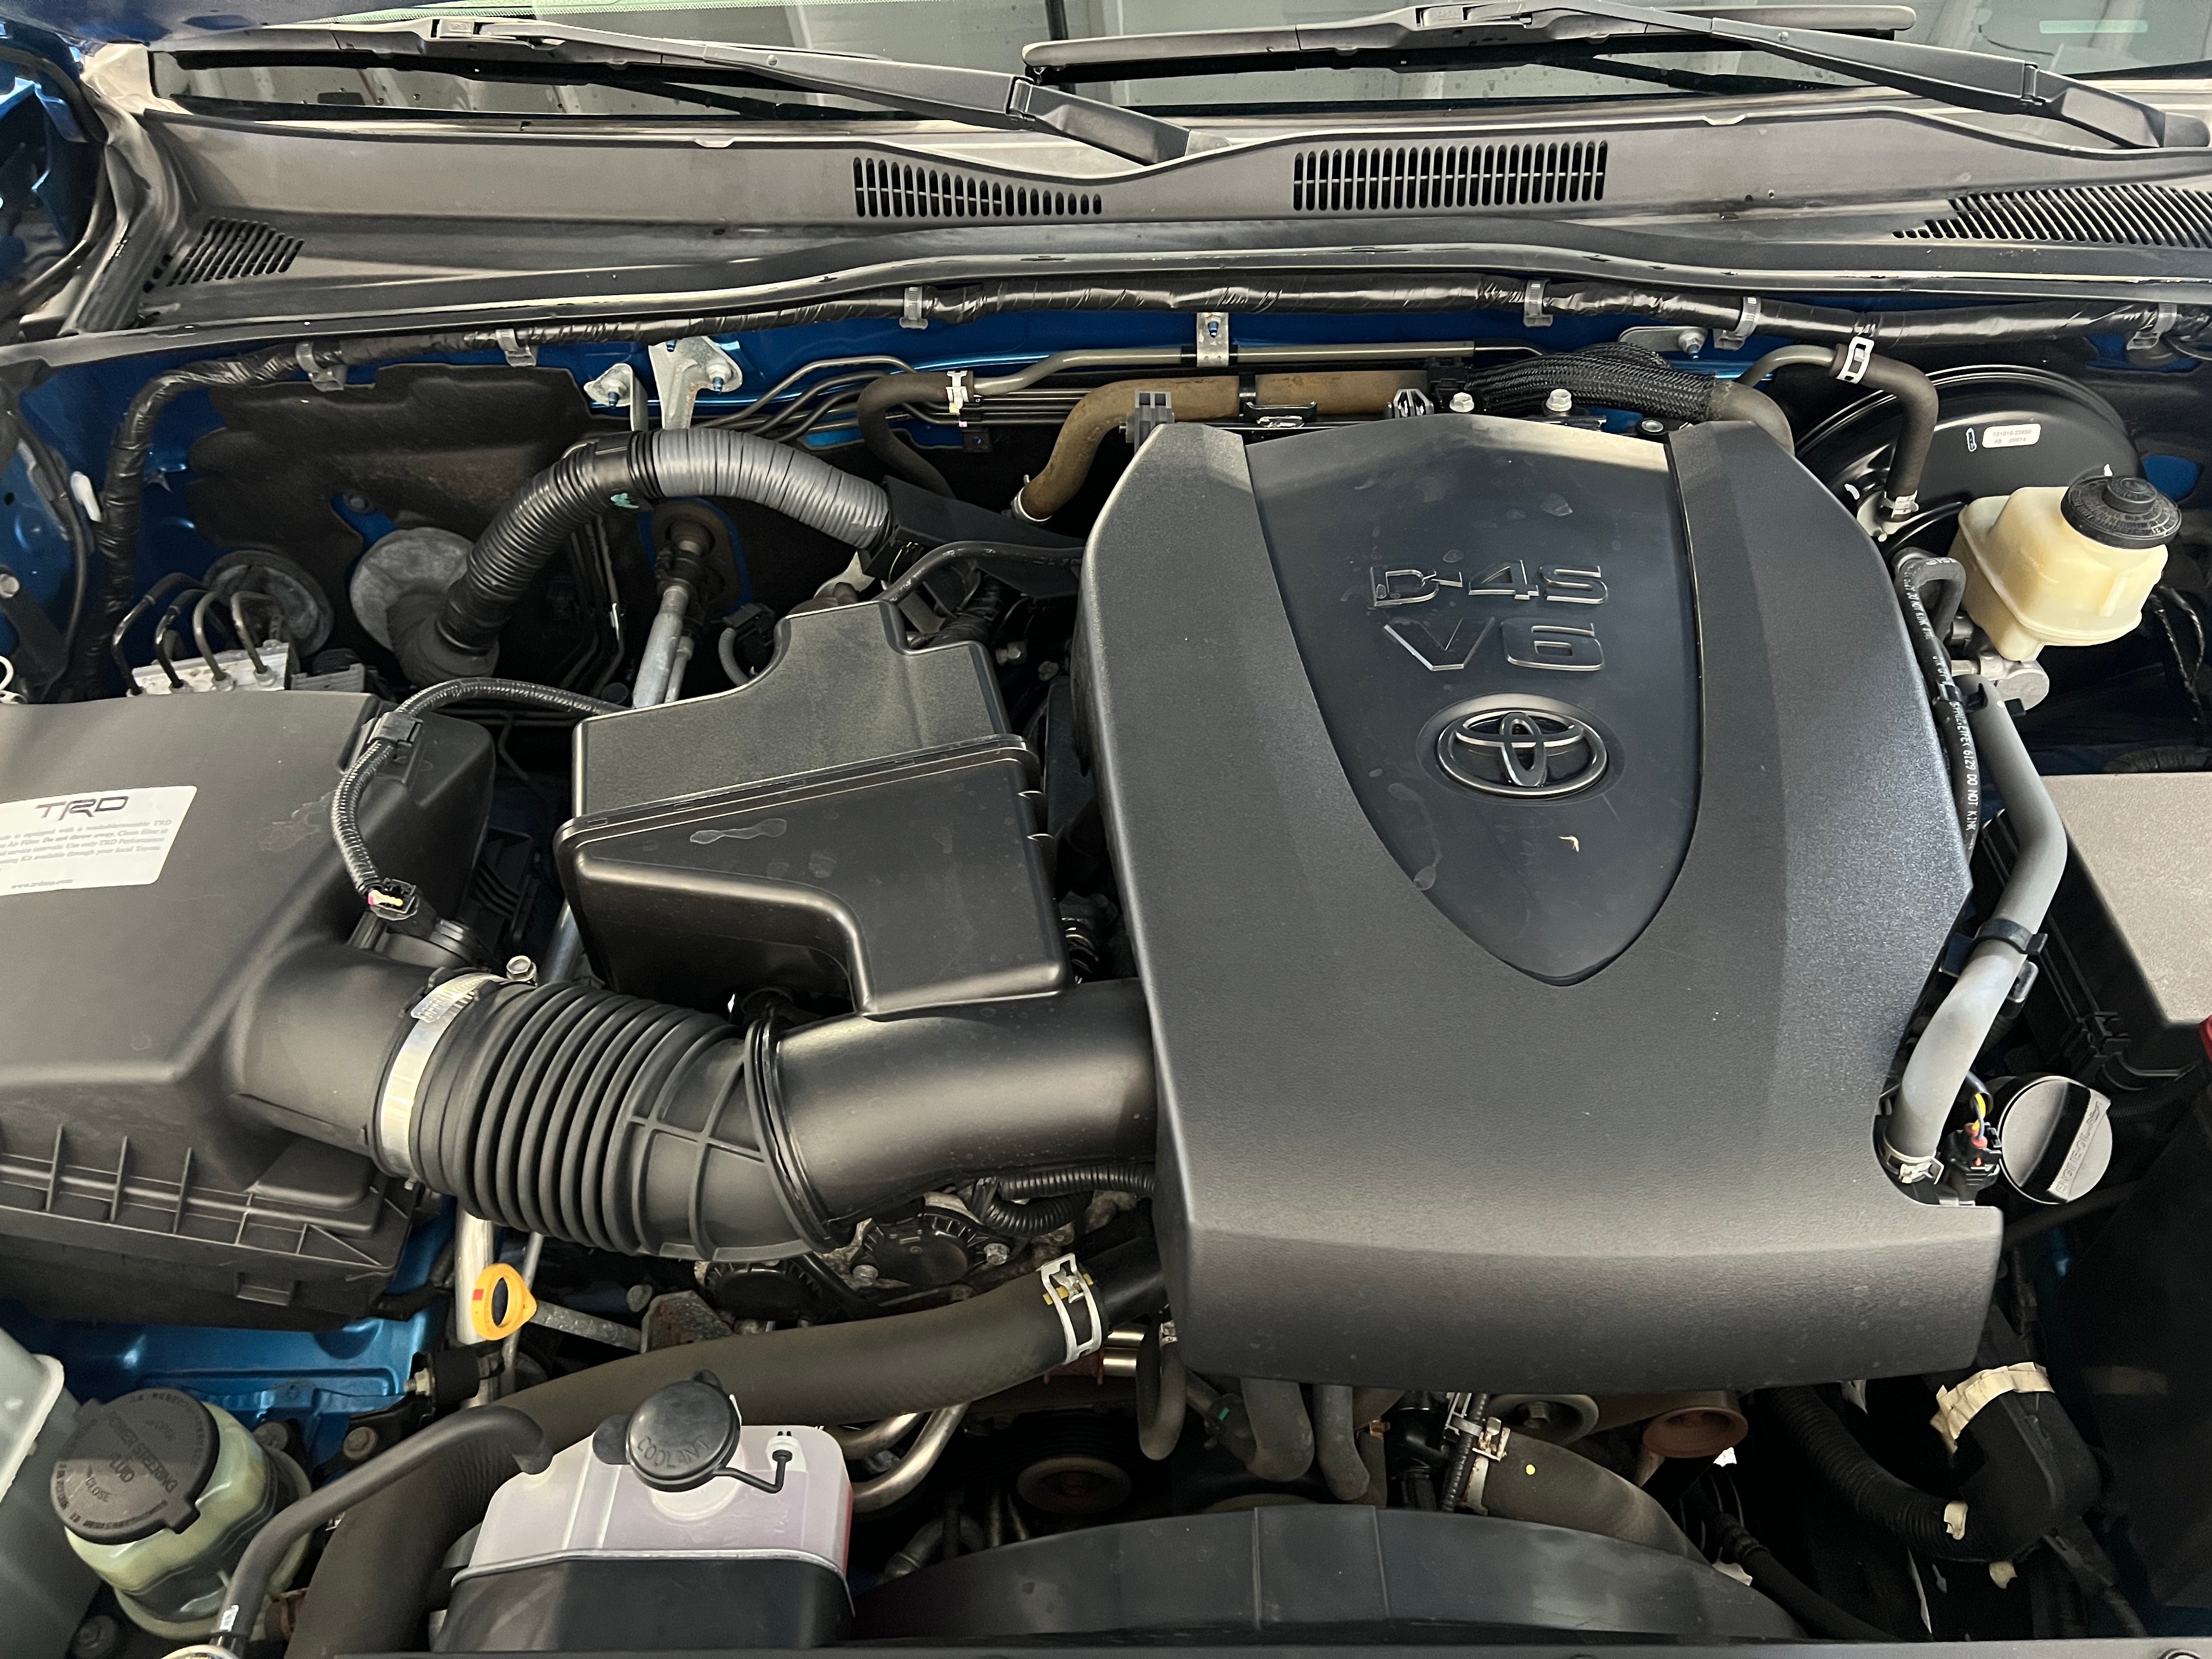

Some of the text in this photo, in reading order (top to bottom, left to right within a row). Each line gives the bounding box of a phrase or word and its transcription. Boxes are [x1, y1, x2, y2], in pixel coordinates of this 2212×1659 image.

[1370, 560, 1608, 607] D-4S
[1384, 617, 1605, 672] V6
[1963, 749, 1976, 771] 6129
[1967, 774, 1978, 786] DO
[35, 796, 129, 821] TRD
[1968, 789, 1978, 806] NOT
[1965, 811, 1978, 831] KINK
[2056, 1150, 2081, 1193] ENGINE
[637, 1431, 710, 1469] COOLANT
[109, 1451, 135, 1482] FLUID
[132, 1442, 178, 1493] STEERING
[85, 1476, 112, 1503] CLOSE
